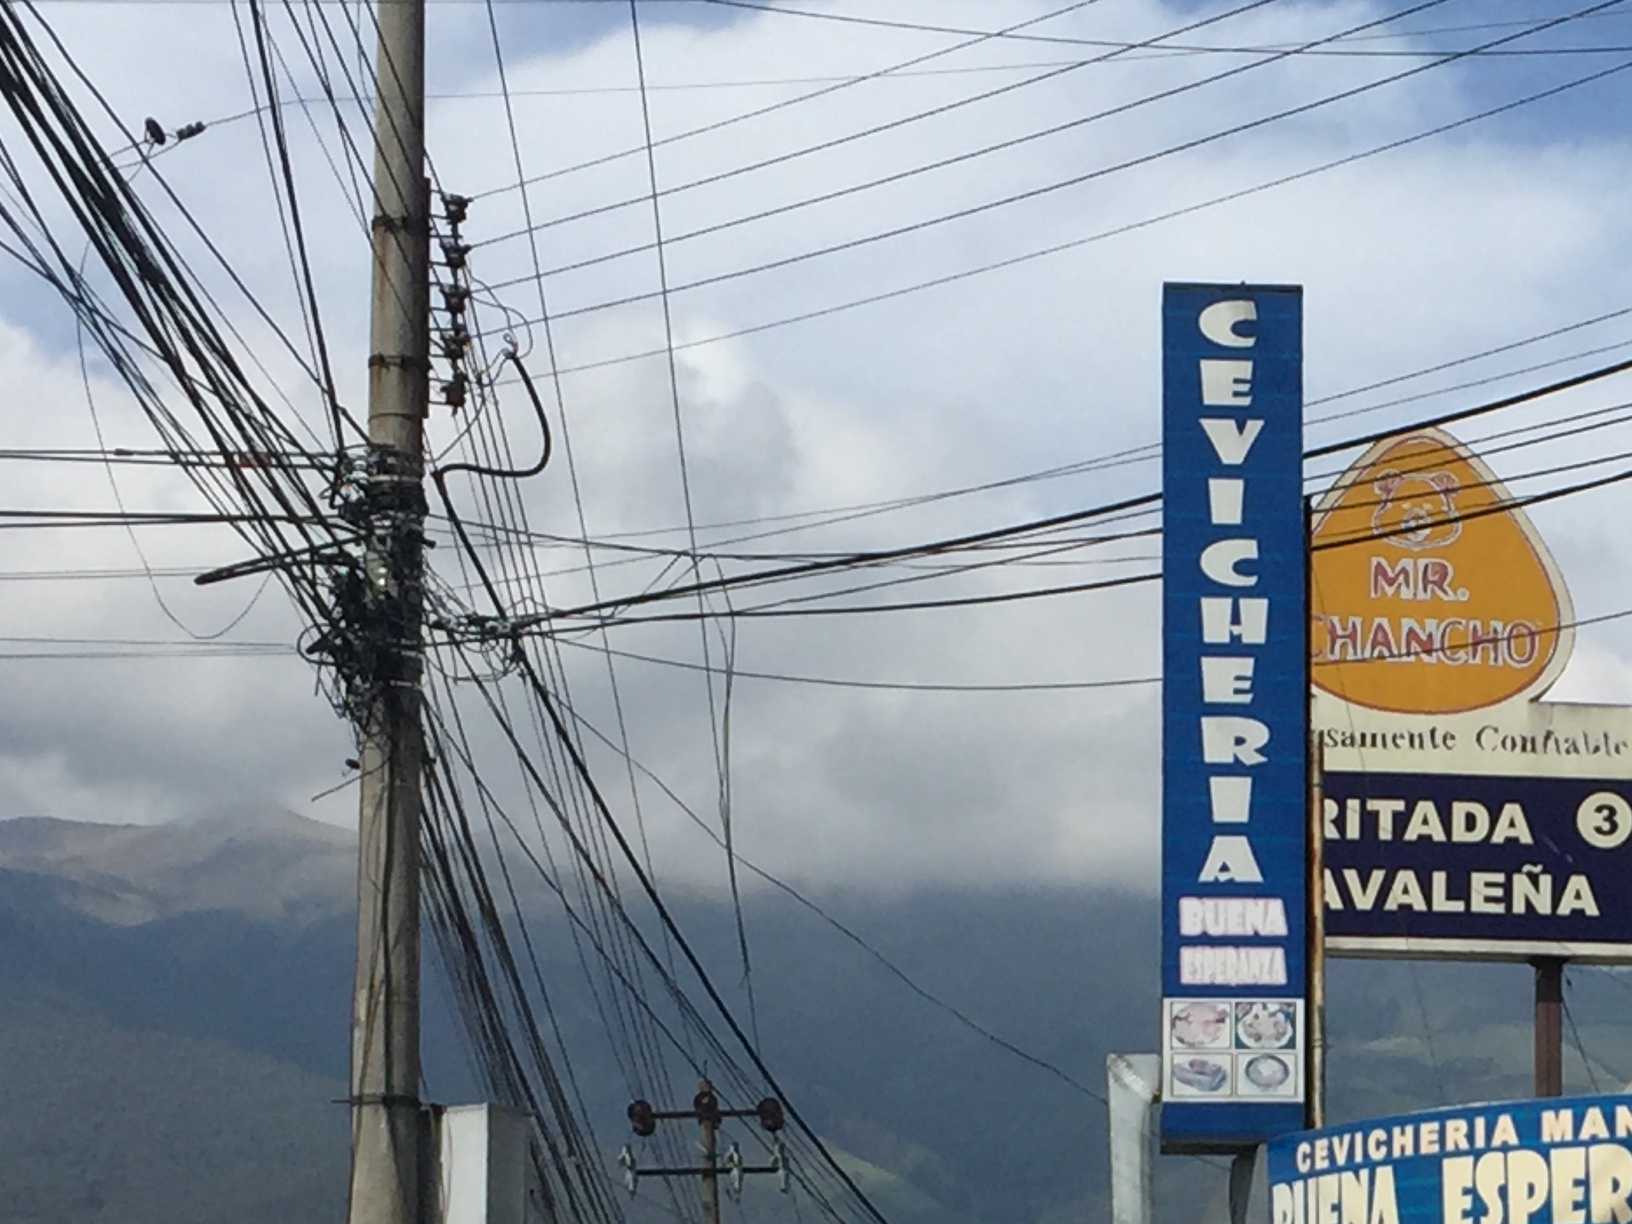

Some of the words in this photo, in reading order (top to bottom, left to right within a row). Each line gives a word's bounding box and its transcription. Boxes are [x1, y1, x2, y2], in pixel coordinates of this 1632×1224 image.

[1198, 299, 1270, 882] CEVICHERIA
[1370, 556, 1469, 601] MR.
[1475, 724, 1629, 757] Confiable
[1592, 804, 1620, 837] 3
[1179, 896, 1288, 937] BUENA
[1180, 946, 1288, 987] ESPERANZA
[1296, 1113, 1519, 1173] CEVICHERIA
